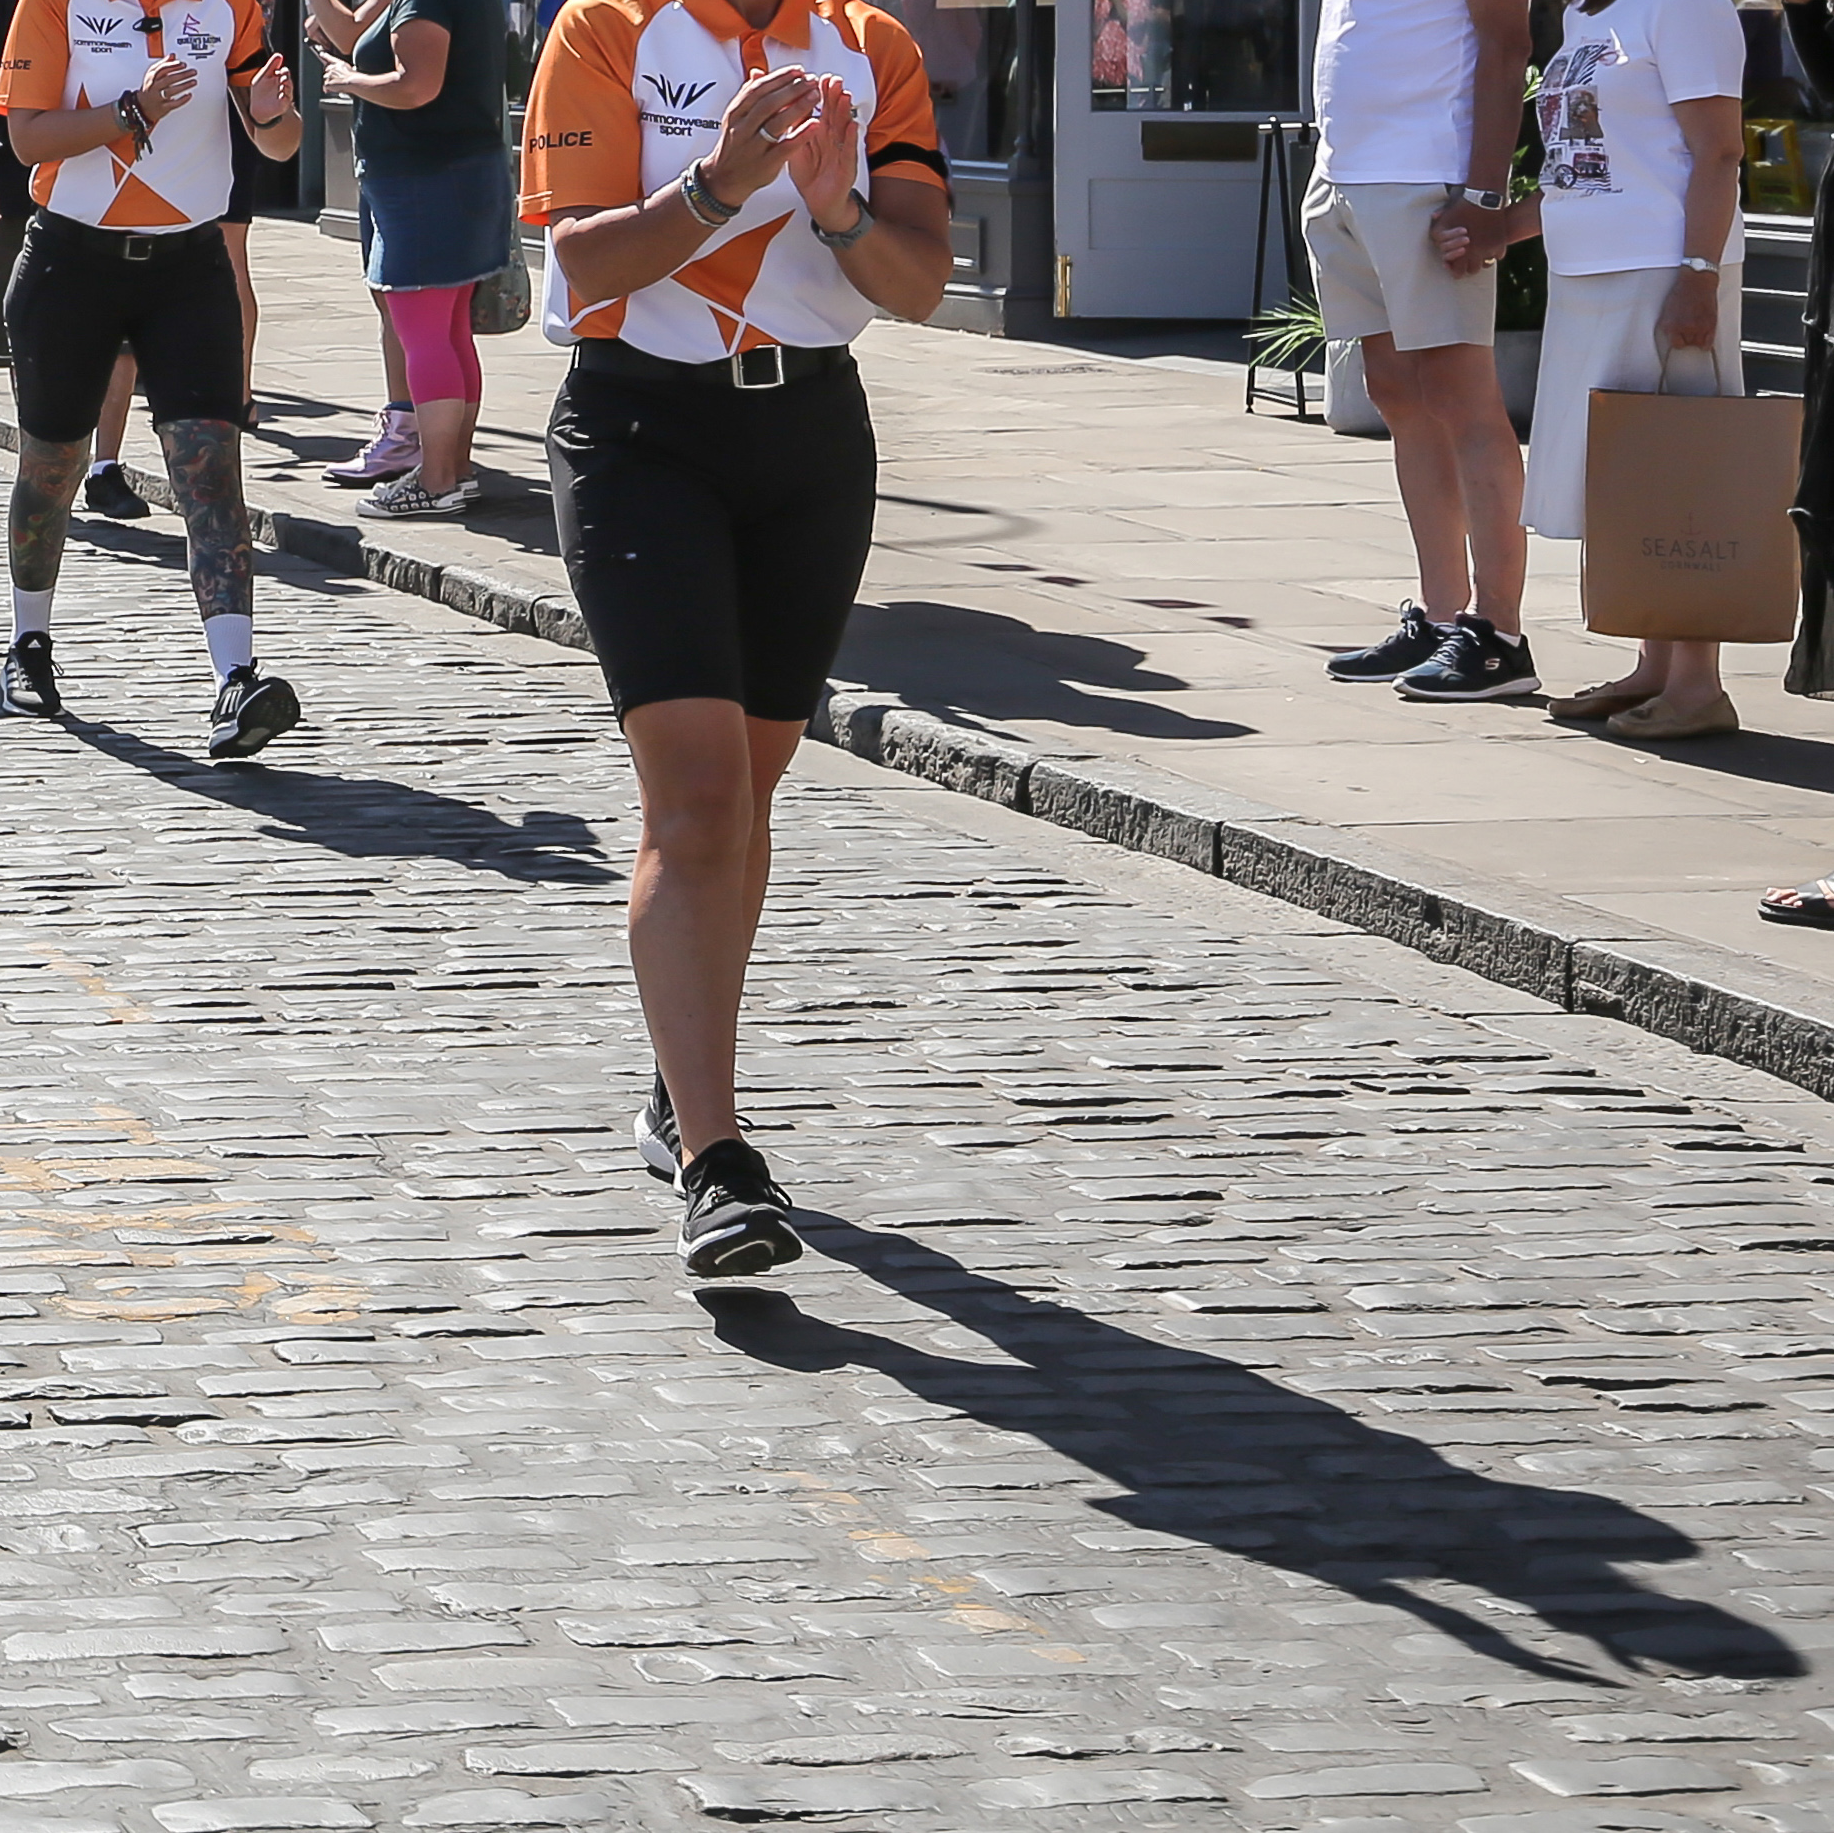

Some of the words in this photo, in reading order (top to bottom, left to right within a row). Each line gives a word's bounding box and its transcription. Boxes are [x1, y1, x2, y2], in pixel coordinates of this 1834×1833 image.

[91, 46, 112, 54] sport
[641, 112, 721, 130] ommonwealth
[660, 125, 692, 137] sport
[529, 130, 593, 154] POLICE
[1641, 537, 1740, 560] SEASALT
